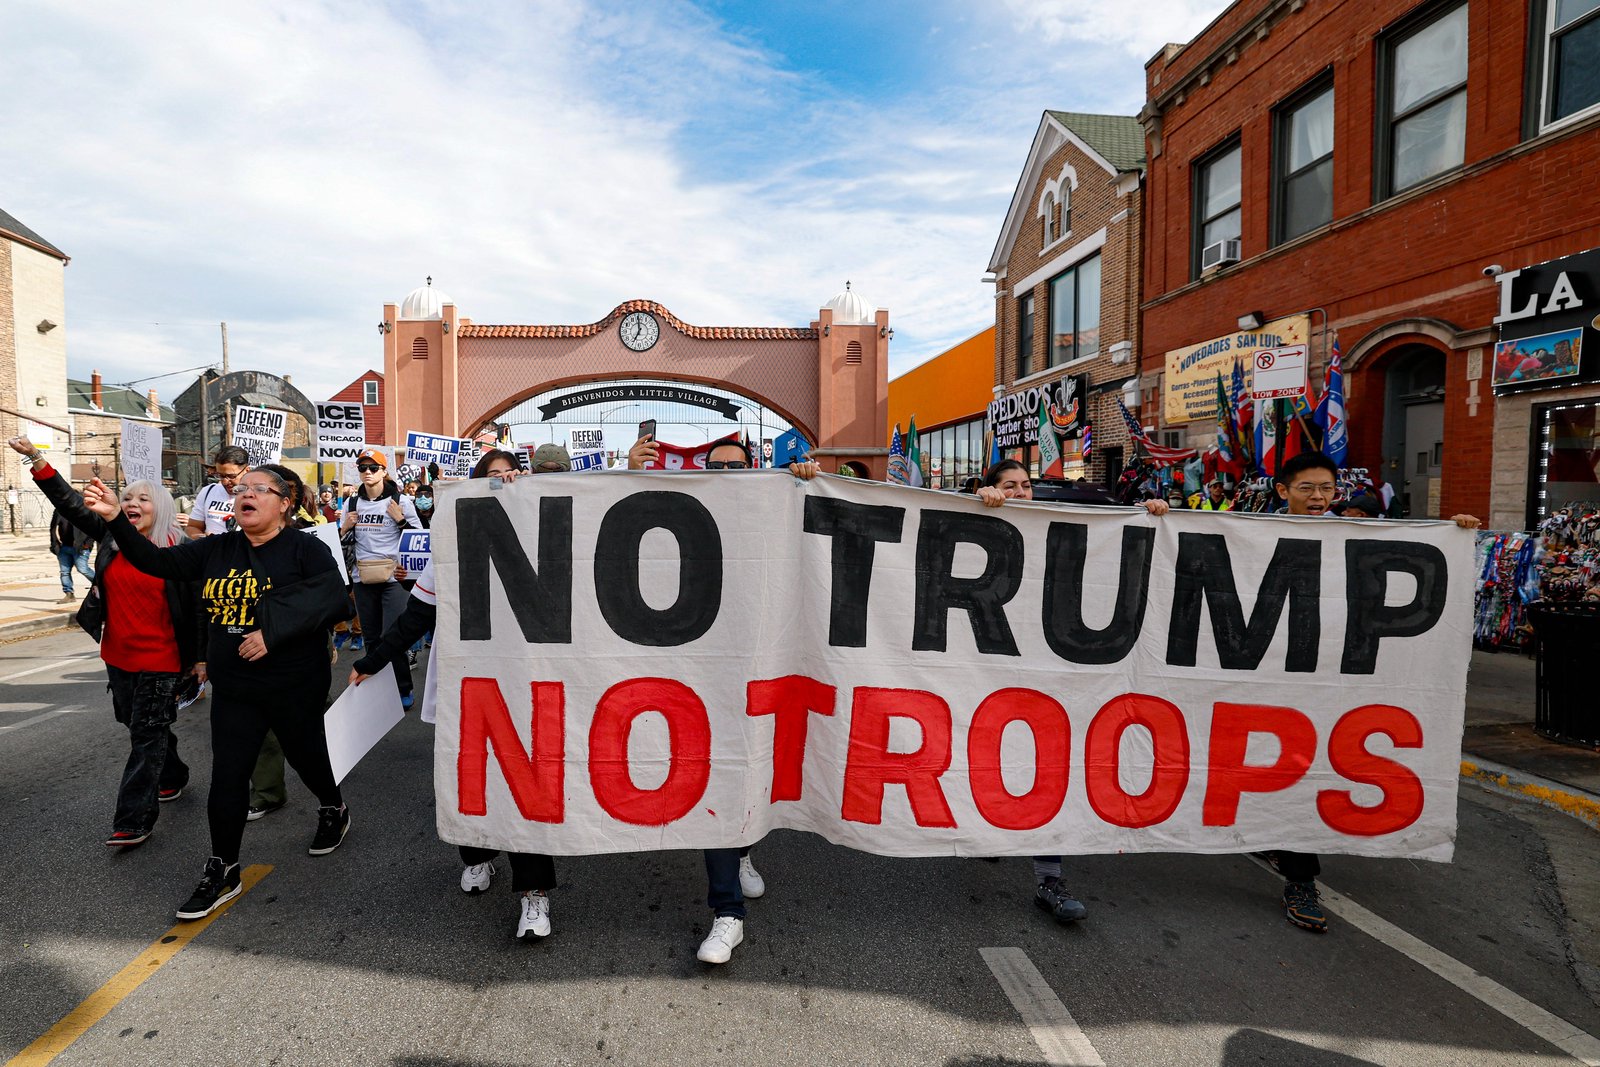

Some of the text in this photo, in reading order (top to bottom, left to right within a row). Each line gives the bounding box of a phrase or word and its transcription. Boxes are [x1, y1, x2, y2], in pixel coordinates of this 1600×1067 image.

[1493, 269, 1583, 325] LA
[1180, 337, 1231, 373] NOVEDADES
[1236, 333, 1257, 348] SAN
[1259, 333, 1283, 348] LUIS
[1171, 381, 1191, 392] Gorras
[1183, 386, 1219, 400] Accesorio
[1255, 387, 1300, 399] TOW ZONE
[561, 389, 718, 407] BIENVENIDOS A LITTLE VILLAGE
[991, 383, 1052, 424] PEDRO'S
[238, 408, 283, 430] DEFEND
[316, 404, 363, 420] ICE
[1188, 410, 1218, 419] Uniform
[236, 423, 281, 439] DEMOCRACY:
[318, 420, 363, 430] OUT OF
[996, 420, 1021, 436] barber
[1023, 415, 1040, 430] sho
[318, 435, 363, 443] CHICAGO
[414, 435, 430, 449] ICE
[431, 437, 452, 452] OUT!
[571, 429, 603, 442] DEFEND
[997, 430, 1039, 447] EAUTY SAL
[248, 438, 265, 450] TIME
[264, 441, 280, 452] FOR
[319, 447, 364, 459] NOW
[439, 452, 456, 466] ICE!
[571, 455, 585, 471] UT!
[208, 500, 235, 512] PILS
[357, 514, 385, 524] ILSEN
[408, 534, 428, 551] ICE
[400, 554, 429, 571] ¡Fuer
[227, 568, 253, 578] LA
[455, 490, 1449, 675] NO TRUMP
[457, 674, 1424, 837] NO TROOPS
